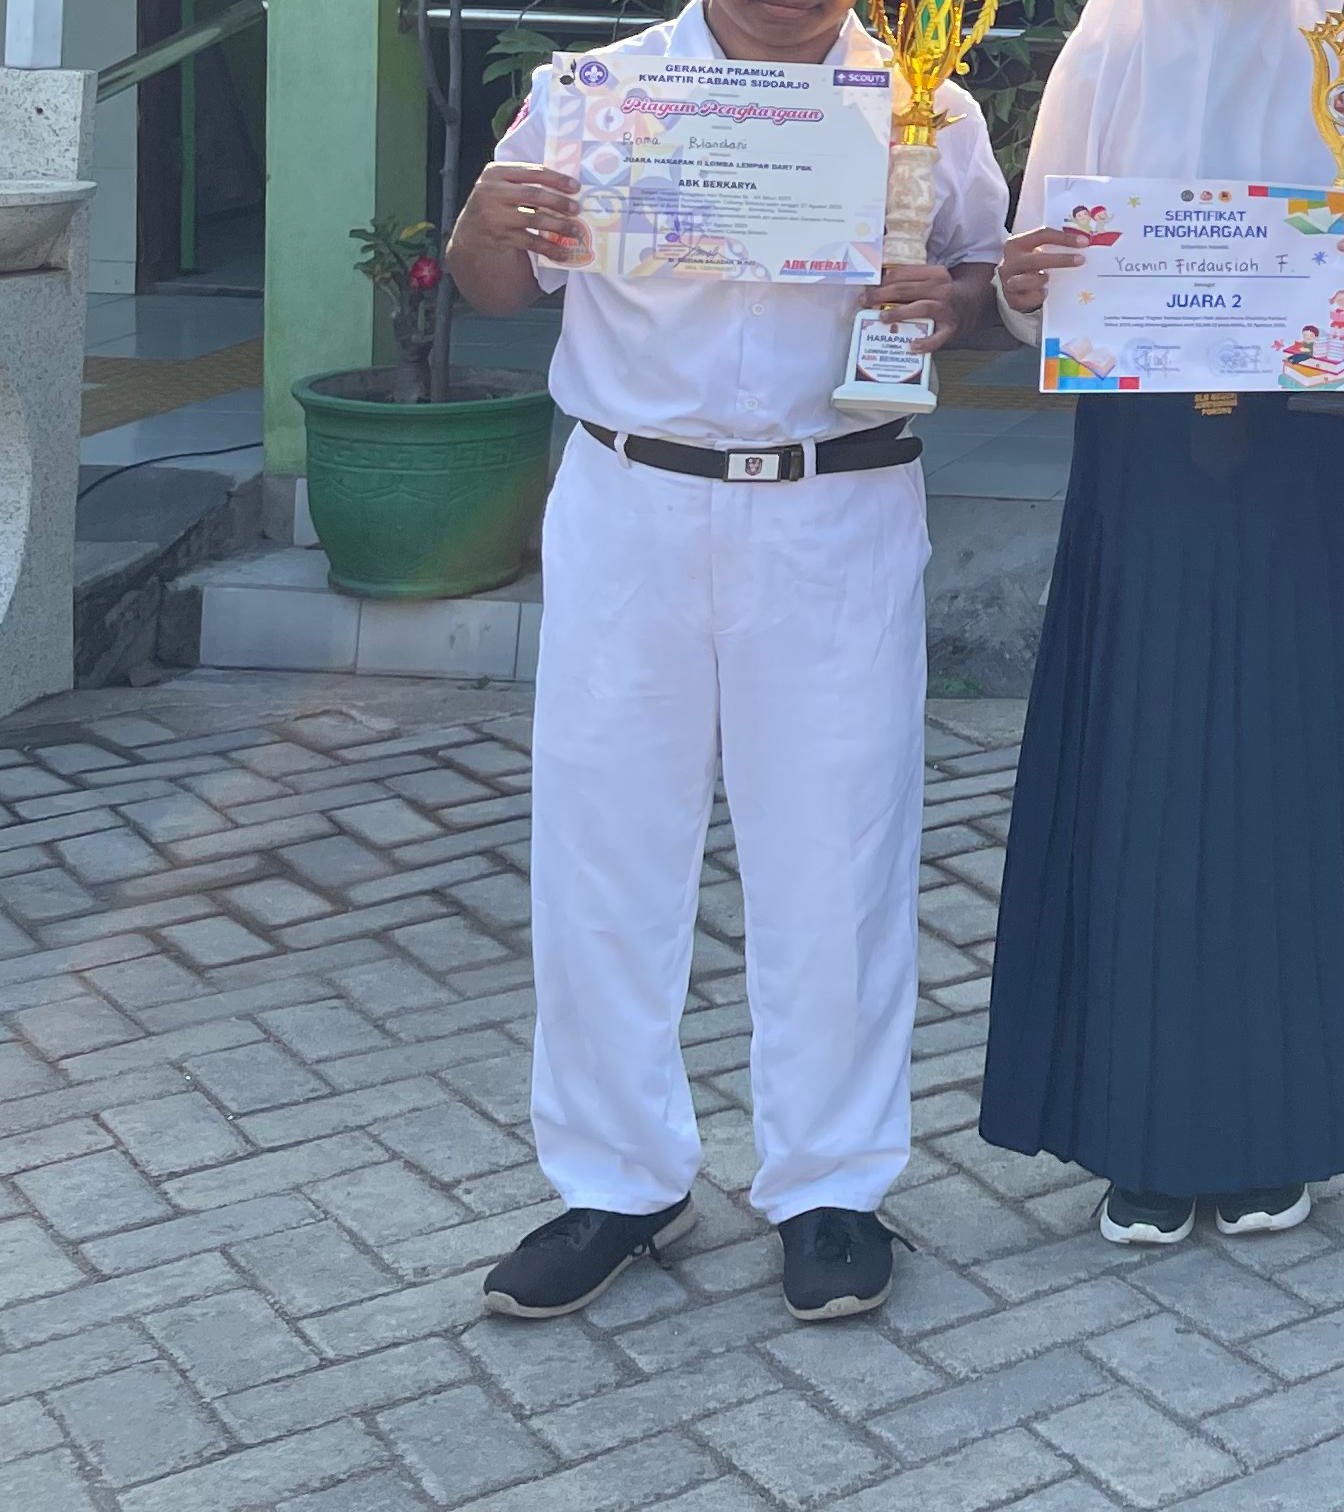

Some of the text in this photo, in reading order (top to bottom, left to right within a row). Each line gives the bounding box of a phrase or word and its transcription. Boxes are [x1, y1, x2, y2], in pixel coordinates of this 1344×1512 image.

[665, 64, 785, 78] GERAKAN PRAMUKA
[847, 72, 886, 83] SCOUTS
[639, 74, 694, 84] KWARTIR
[698, 76, 747, 87] CABANG
[621, 96, 824, 125] Piagam Penghargaan
[678, 179, 757, 190] ABK BERKARYA
[1165, 210, 1247, 222] SERTIFIKAT
[1143, 225, 1268, 238] PENGHARGAAN
[810, 259, 849, 272] HEBAT
[1115, 256, 1168, 272] Yasmin
[1166, 293, 1242, 308] JUARA 2
